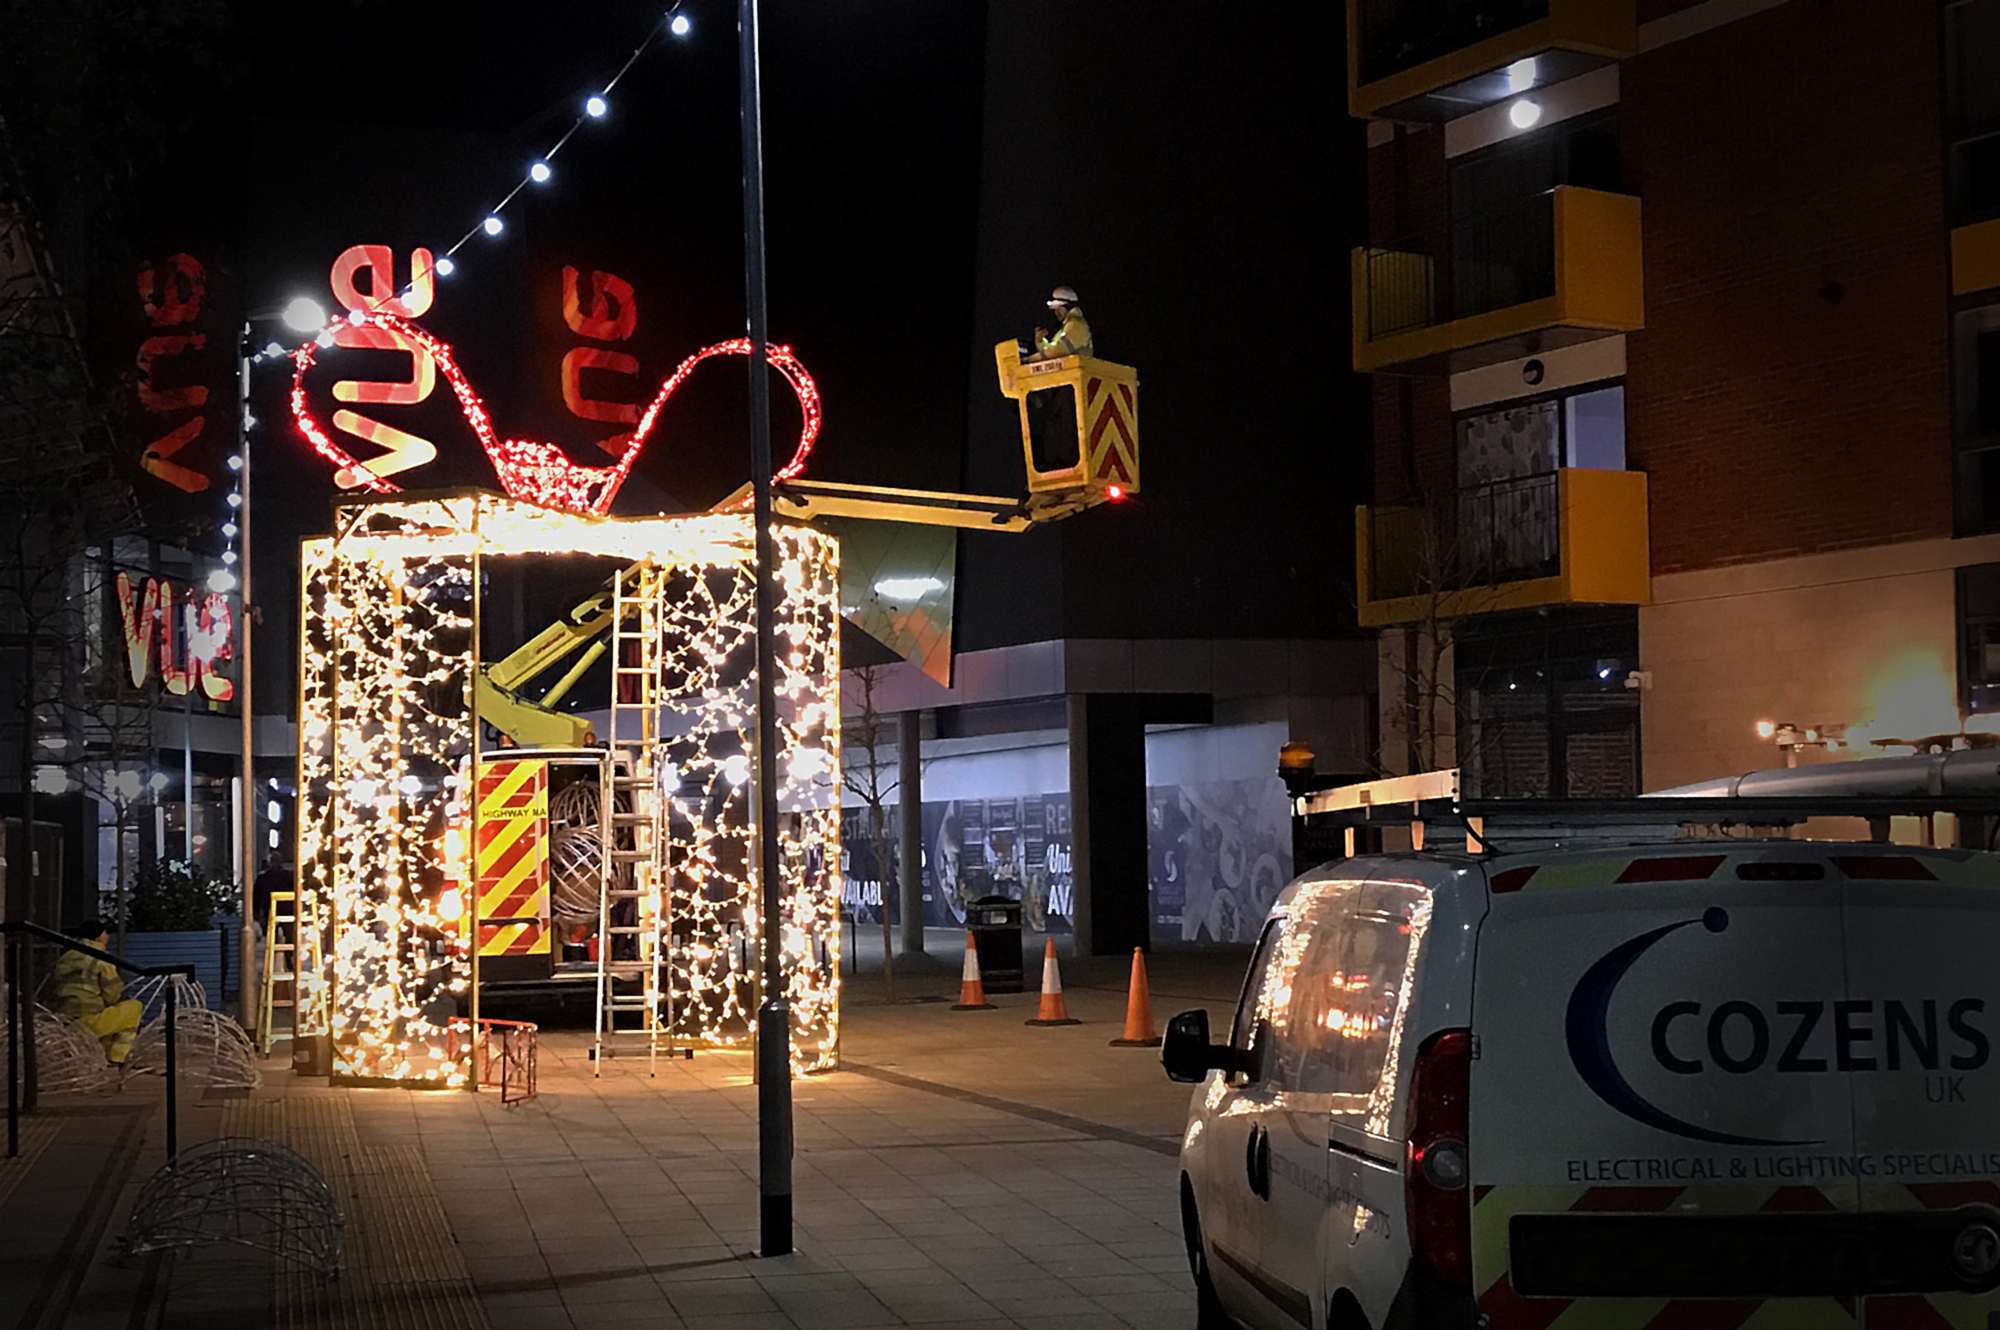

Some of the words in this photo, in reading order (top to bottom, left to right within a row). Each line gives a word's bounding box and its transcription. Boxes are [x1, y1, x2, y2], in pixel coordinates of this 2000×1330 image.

[483, 808, 529, 818] HIGHWAY
[1045, 804, 1072, 834] RE
[1047, 843, 1072, 874] Uni
[1047, 884, 1073, 916] AV
[1652, 999, 1989, 1075] COZENS
[1925, 1076, 1966, 1103] UK
[1568, 1158, 1722, 1181] ELECTRICAL
[1730, 1158, 1747, 1178] &
[1754, 1155, 1877, 1178] LIGHTING
